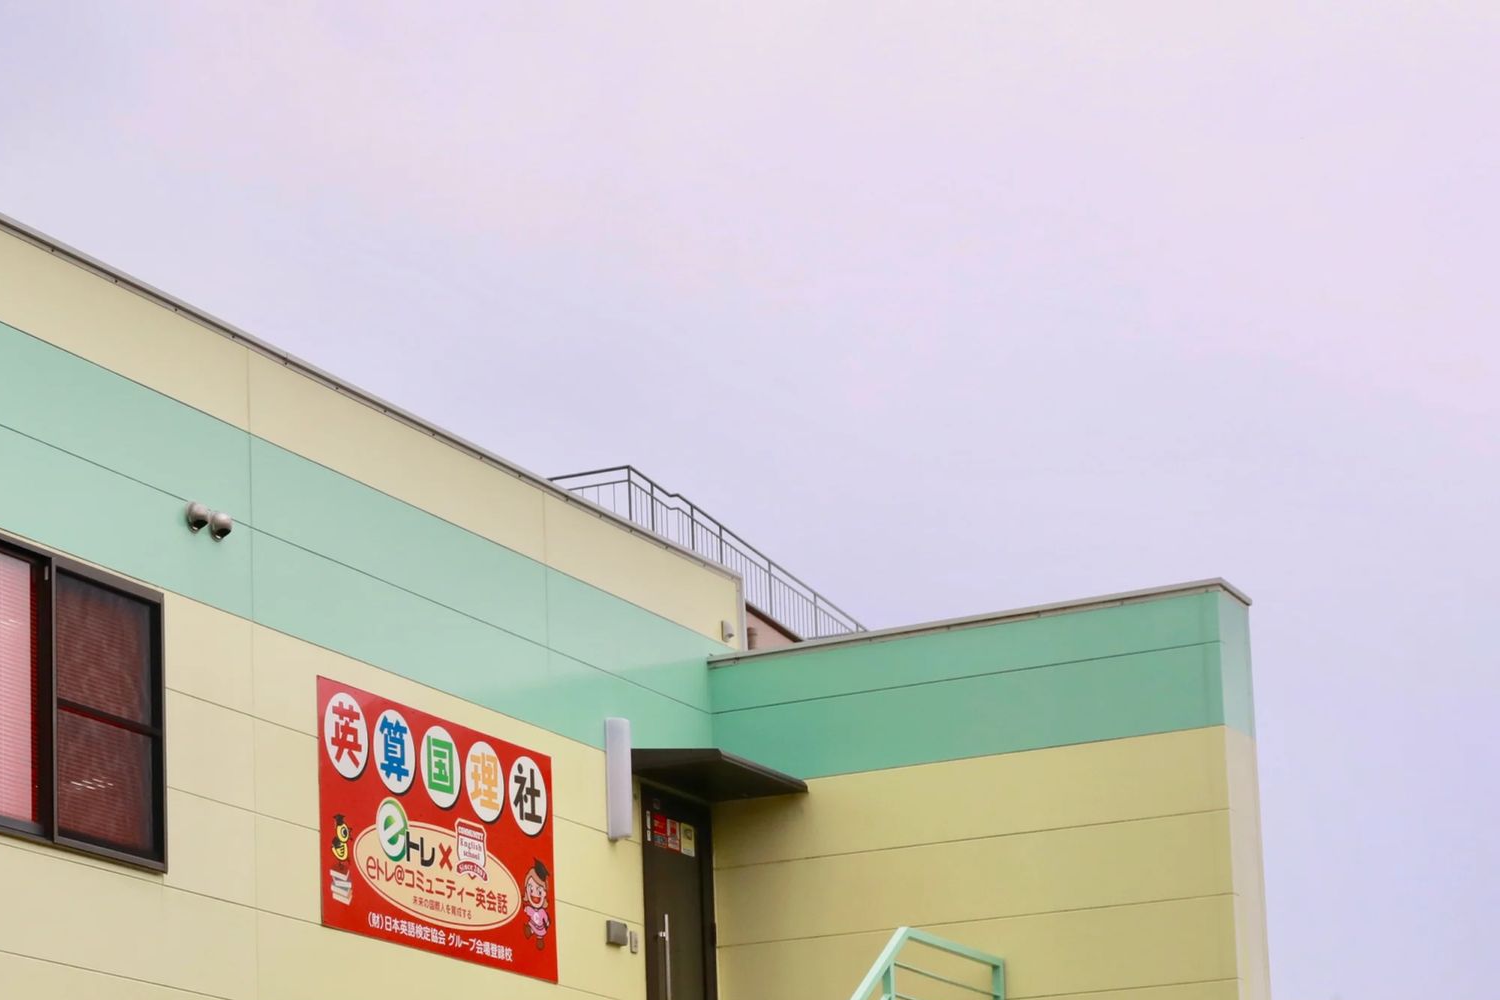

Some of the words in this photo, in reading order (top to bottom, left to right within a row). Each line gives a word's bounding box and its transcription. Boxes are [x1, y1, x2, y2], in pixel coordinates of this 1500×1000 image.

[366, 855, 508, 915] eトレ@コミュニティー英会話
